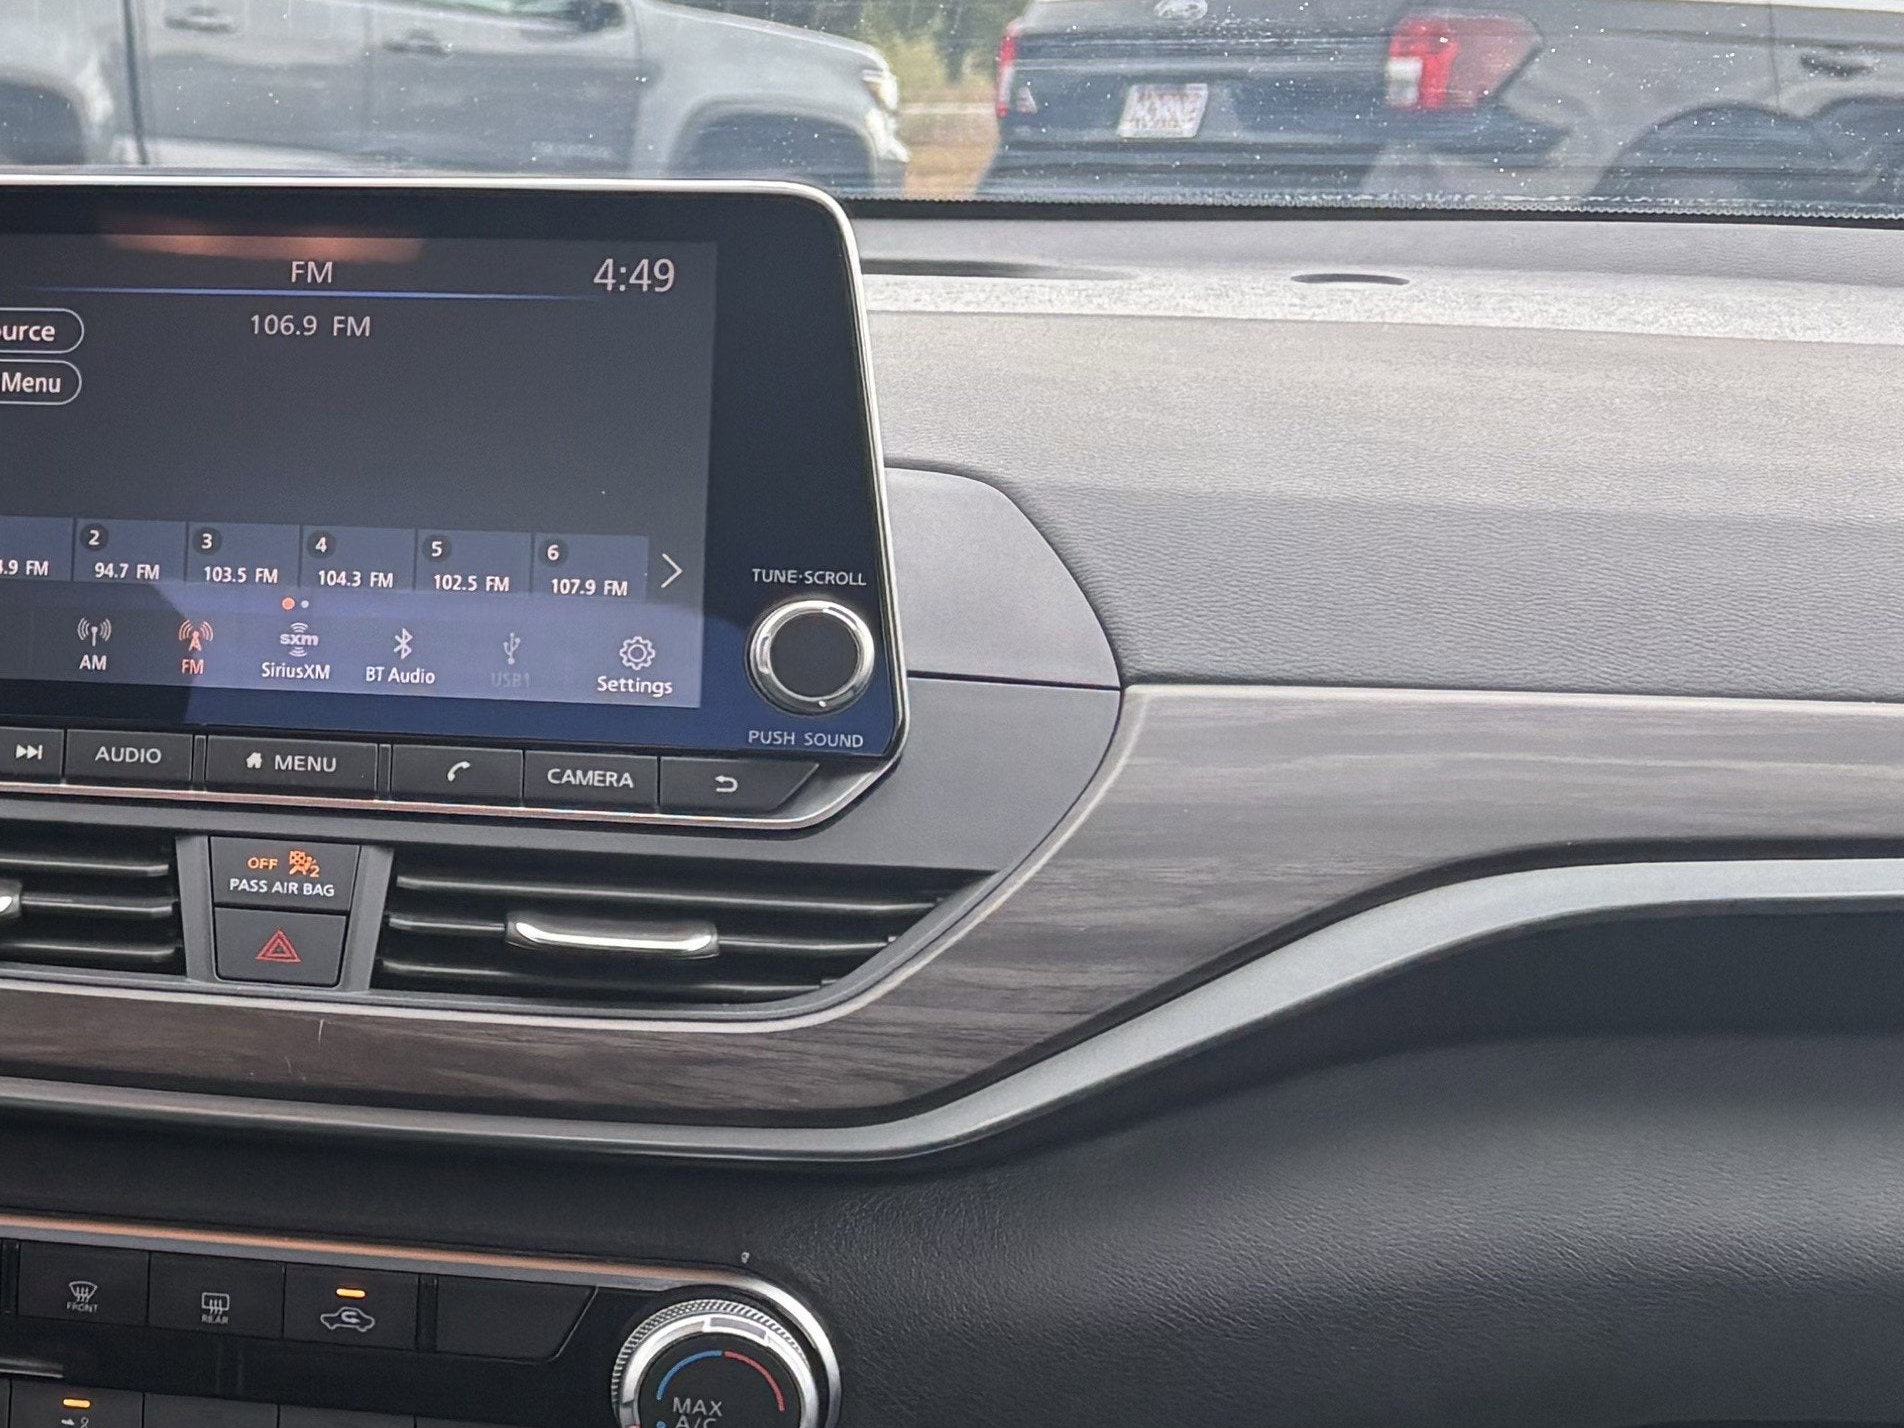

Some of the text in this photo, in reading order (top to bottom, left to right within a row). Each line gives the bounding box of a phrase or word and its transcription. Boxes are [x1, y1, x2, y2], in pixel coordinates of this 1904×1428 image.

[292, 261, 334, 284] FM
[593, 258, 675, 293] 4:49
[250, 314, 371, 338] 106.9 FM
[1, 370, 62, 393] Menu
[88, 530, 101, 546] 2
[201, 533, 213, 549] 3
[315, 537, 328, 553] 4
[431, 541, 443, 557] 5
[547, 545, 559, 561] 6
[26, 560, 49, 576] FM
[94, 563, 160, 580] 94.7 FM
[203, 566, 278, 584] 103.5 FM
[318, 570, 394, 588] 104.3 FM
[433, 574, 510, 592] 102.5 FM
[551, 578, 628, 596] 107.9 FM
[79, 654, 108, 671] AM
[181, 659, 204, 675] FM
[261, 662, 331, 680] SiriusXM
[365, 666, 436, 684] BT Audio
[597, 675, 673, 699] Settings
[748, 730, 863, 748] PUSH SOUND
[95, 745, 162, 765] AUDIO
[274, 753, 337, 773] MENU
[547, 767, 634, 789] CAMERA
[247, 856, 278, 871] OFF
[230, 878, 335, 897] PASS AIR BAG
[66, 1301, 98, 1313] FRONT
[201, 1314, 229, 1324] REAR
[672, 1396, 722, 1416] MAX
